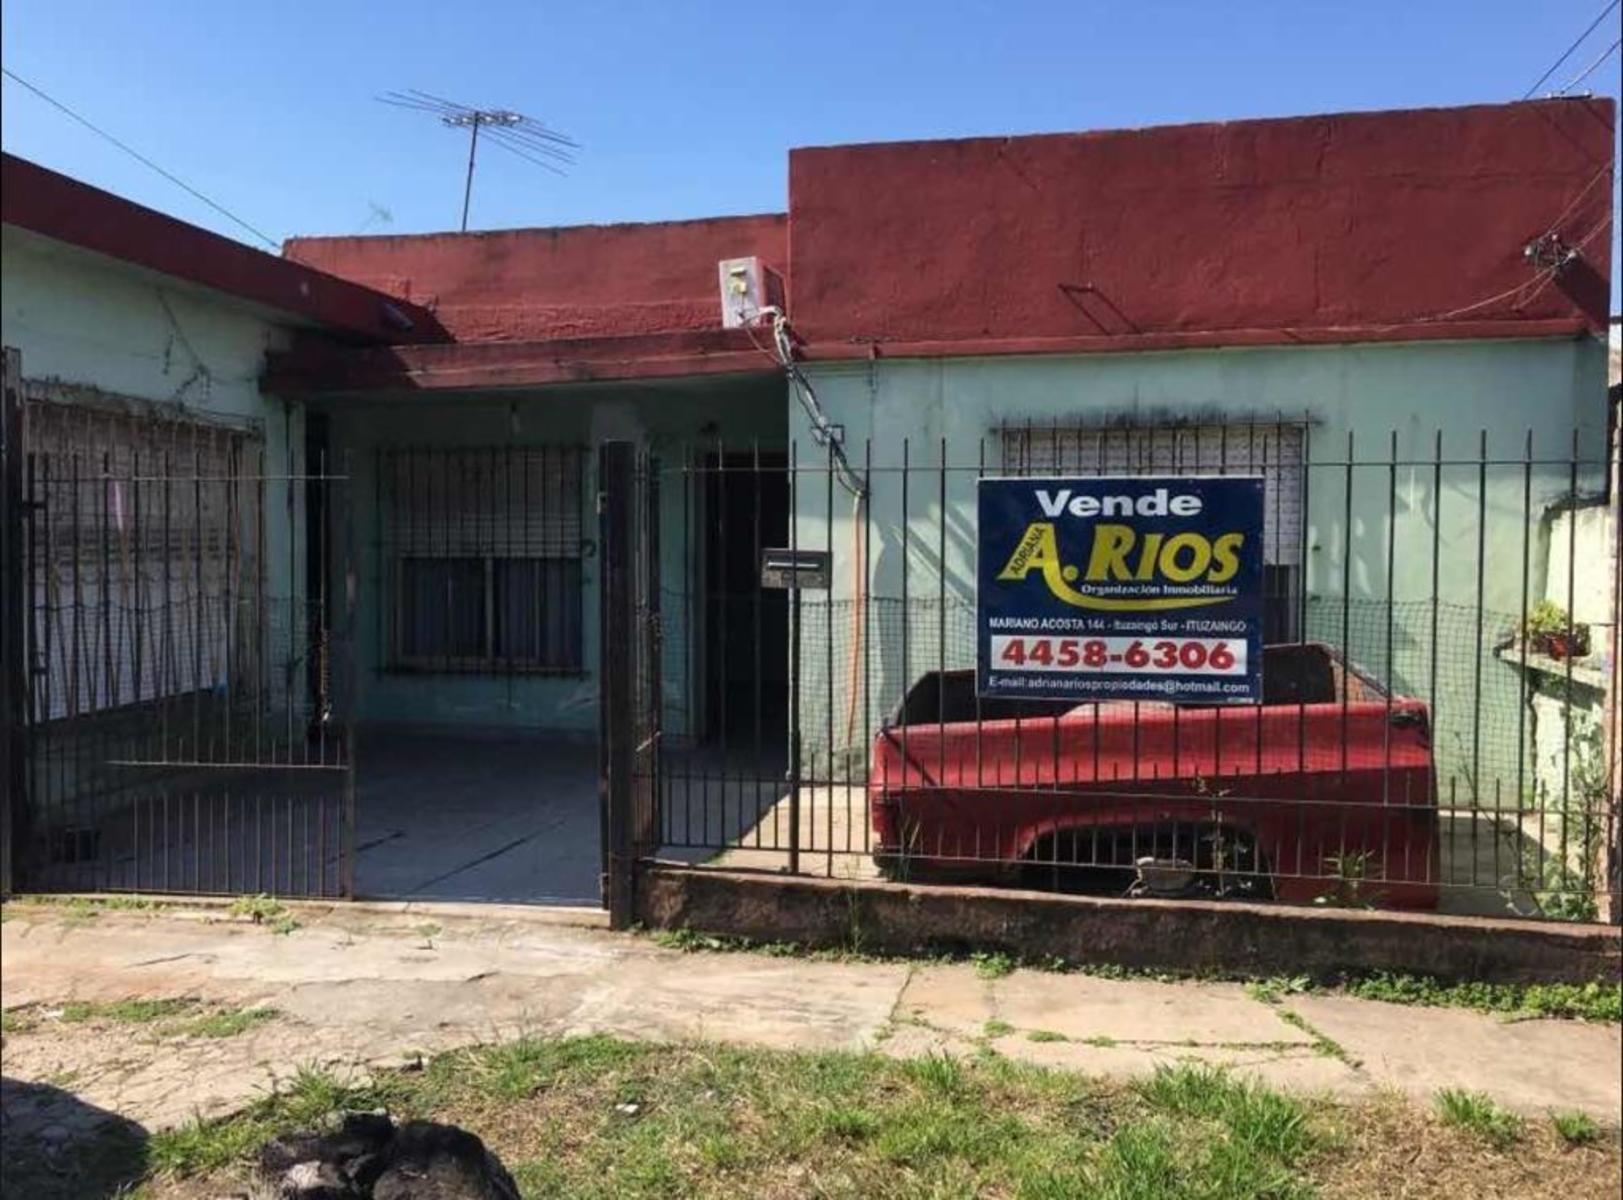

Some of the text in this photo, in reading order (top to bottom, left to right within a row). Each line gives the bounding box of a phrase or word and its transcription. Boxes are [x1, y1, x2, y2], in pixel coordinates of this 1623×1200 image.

[1035, 488, 1203, 518] Vende
[1009, 526, 1046, 575] ADRIANA
[1163, 584, 1237, 595] Inmobiliaria
[989, 617, 1038, 629] MARIANO
[1040, 618, 1085, 629] ACOSTA
[1087, 619, 1105, 629] 144
[1160, 619, 1179, 631] Sur
[1001, 638, 1236, 670] 4458-6306
